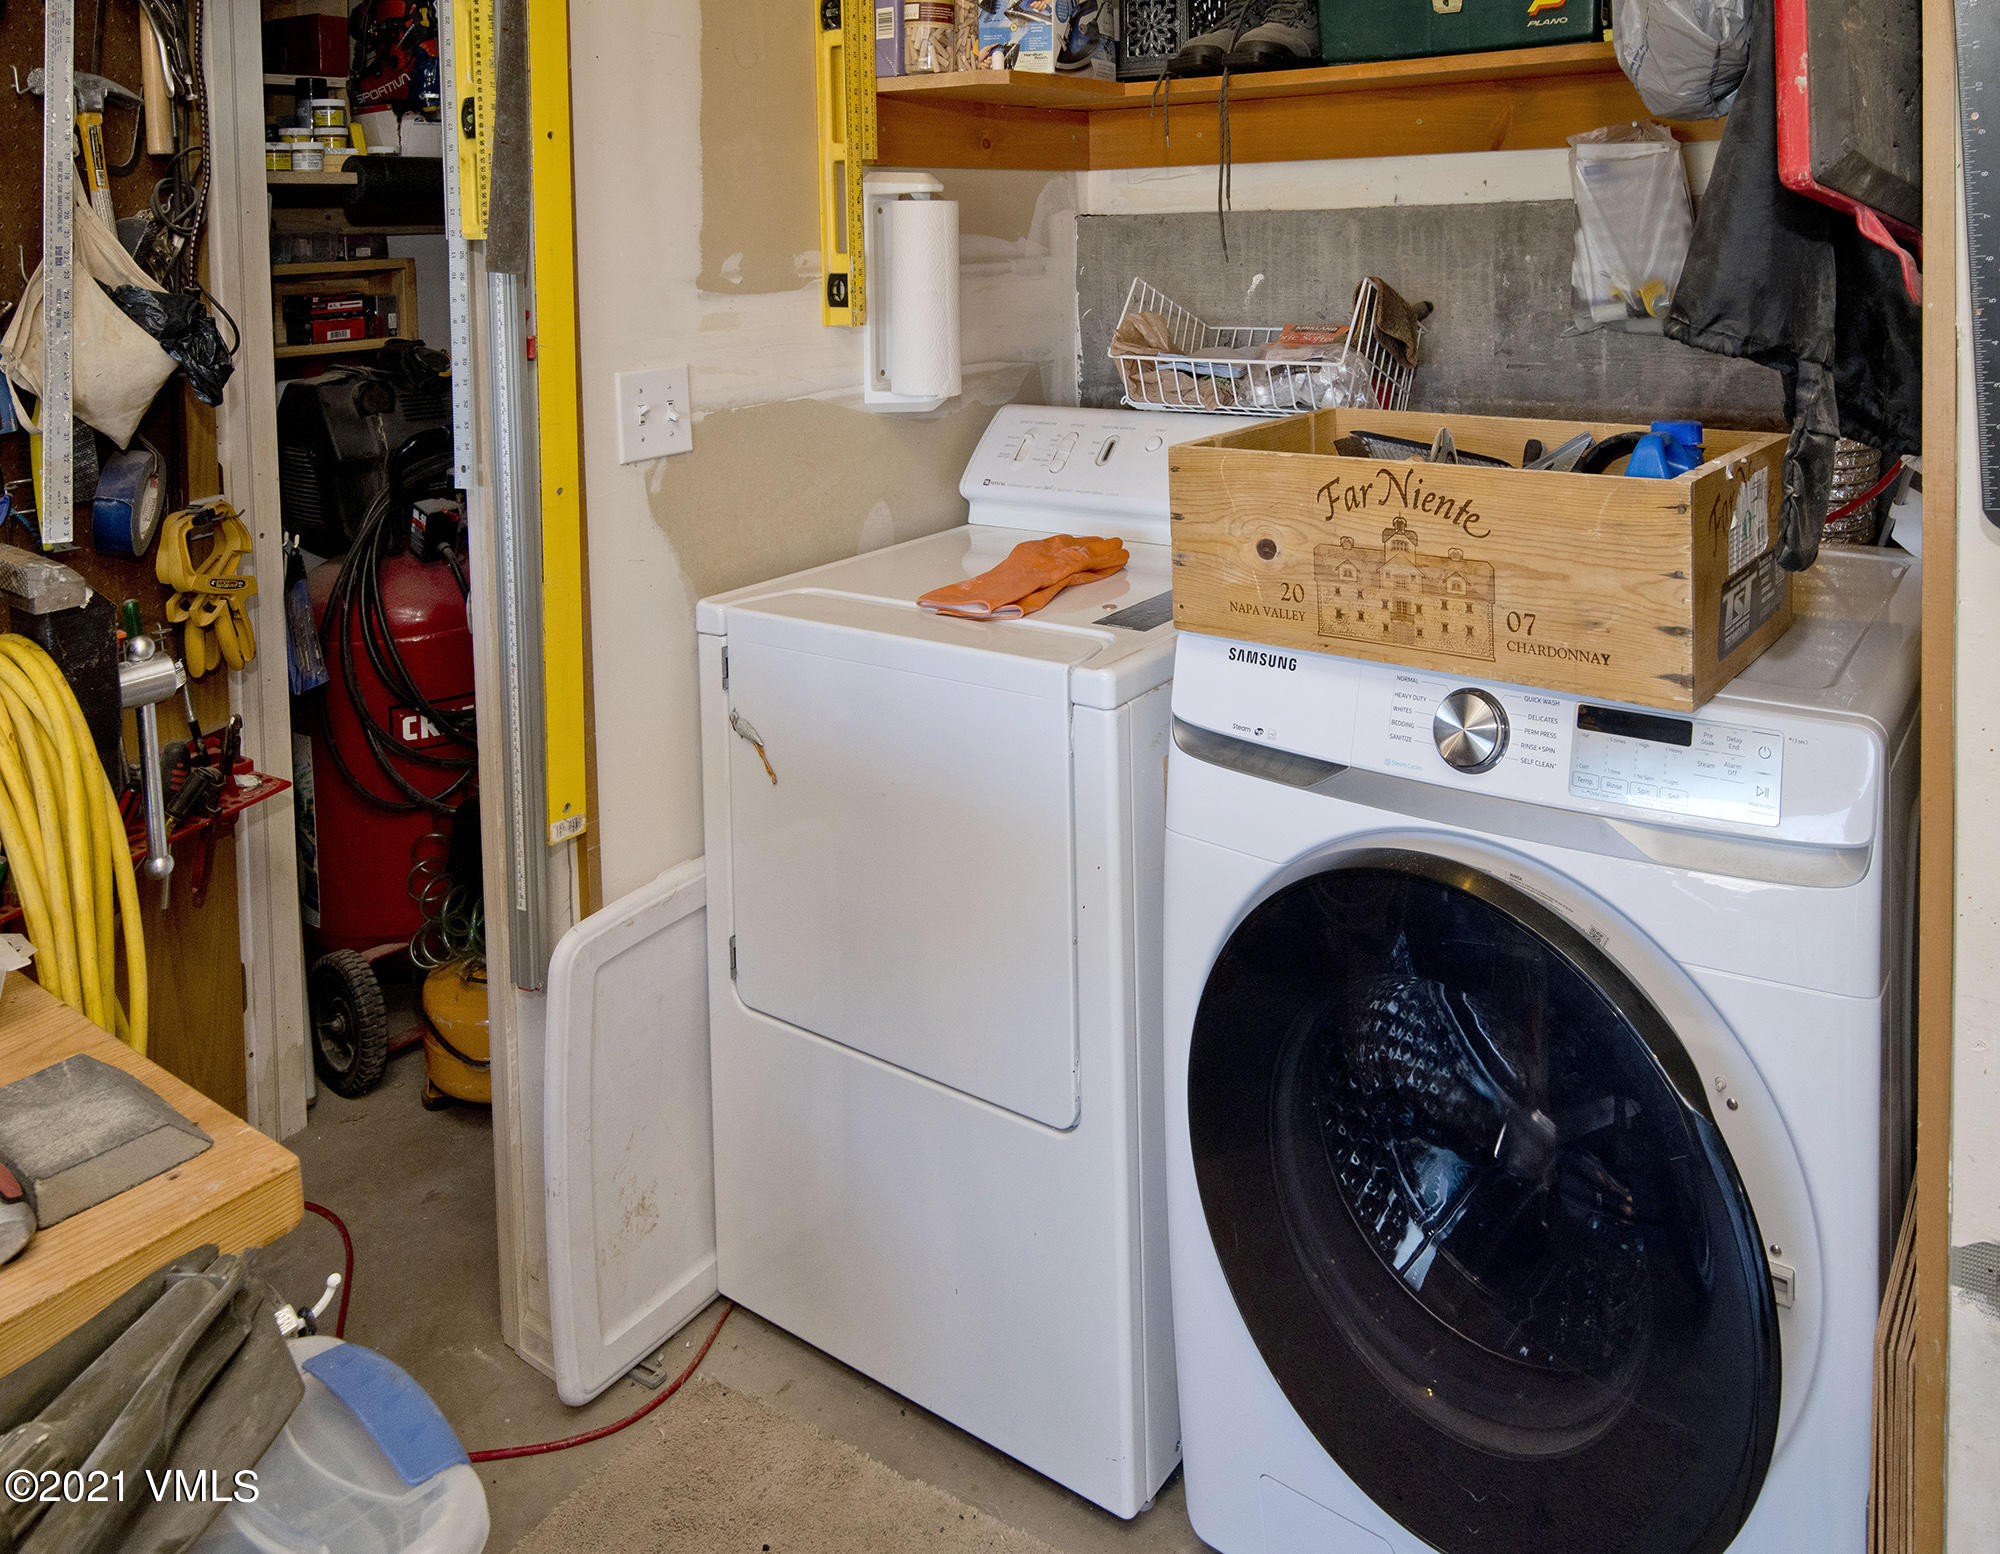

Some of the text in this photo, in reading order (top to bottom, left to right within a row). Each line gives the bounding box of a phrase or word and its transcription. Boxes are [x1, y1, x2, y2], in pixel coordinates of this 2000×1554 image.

[1527, 16, 1568, 28] PLANO
[356, 72, 412, 104] SPORTIVA
[1975, 81, 1983, 91] 10
[1317, 468, 1491, 538] Far Niente
[1280, 582, 1304, 603] 20
[1229, 602, 1306, 621] NAPA VALLEY
[1506, 611, 1536, 636] 07
[1506, 640, 1611, 666] CHARDONNAY
[1228, 648, 1297, 671] SAMSUNG
[1396, 676, 1419, 684] NORMAL
[1394, 692, 1412, 700] HEAVY
[1524, 696, 1542, 704] QUICK
[1392, 719, 1414, 728] BEDDING
[1528, 714, 1558, 724] DELICATES
[1232, 723, 1251, 733] Steam
[1389, 734, 1412, 743] SANITIZE
[1540, 731, 1556, 739] PRESS
[1726, 736, 1743, 744] Delay
[1520, 742, 1537, 752] RINSE
